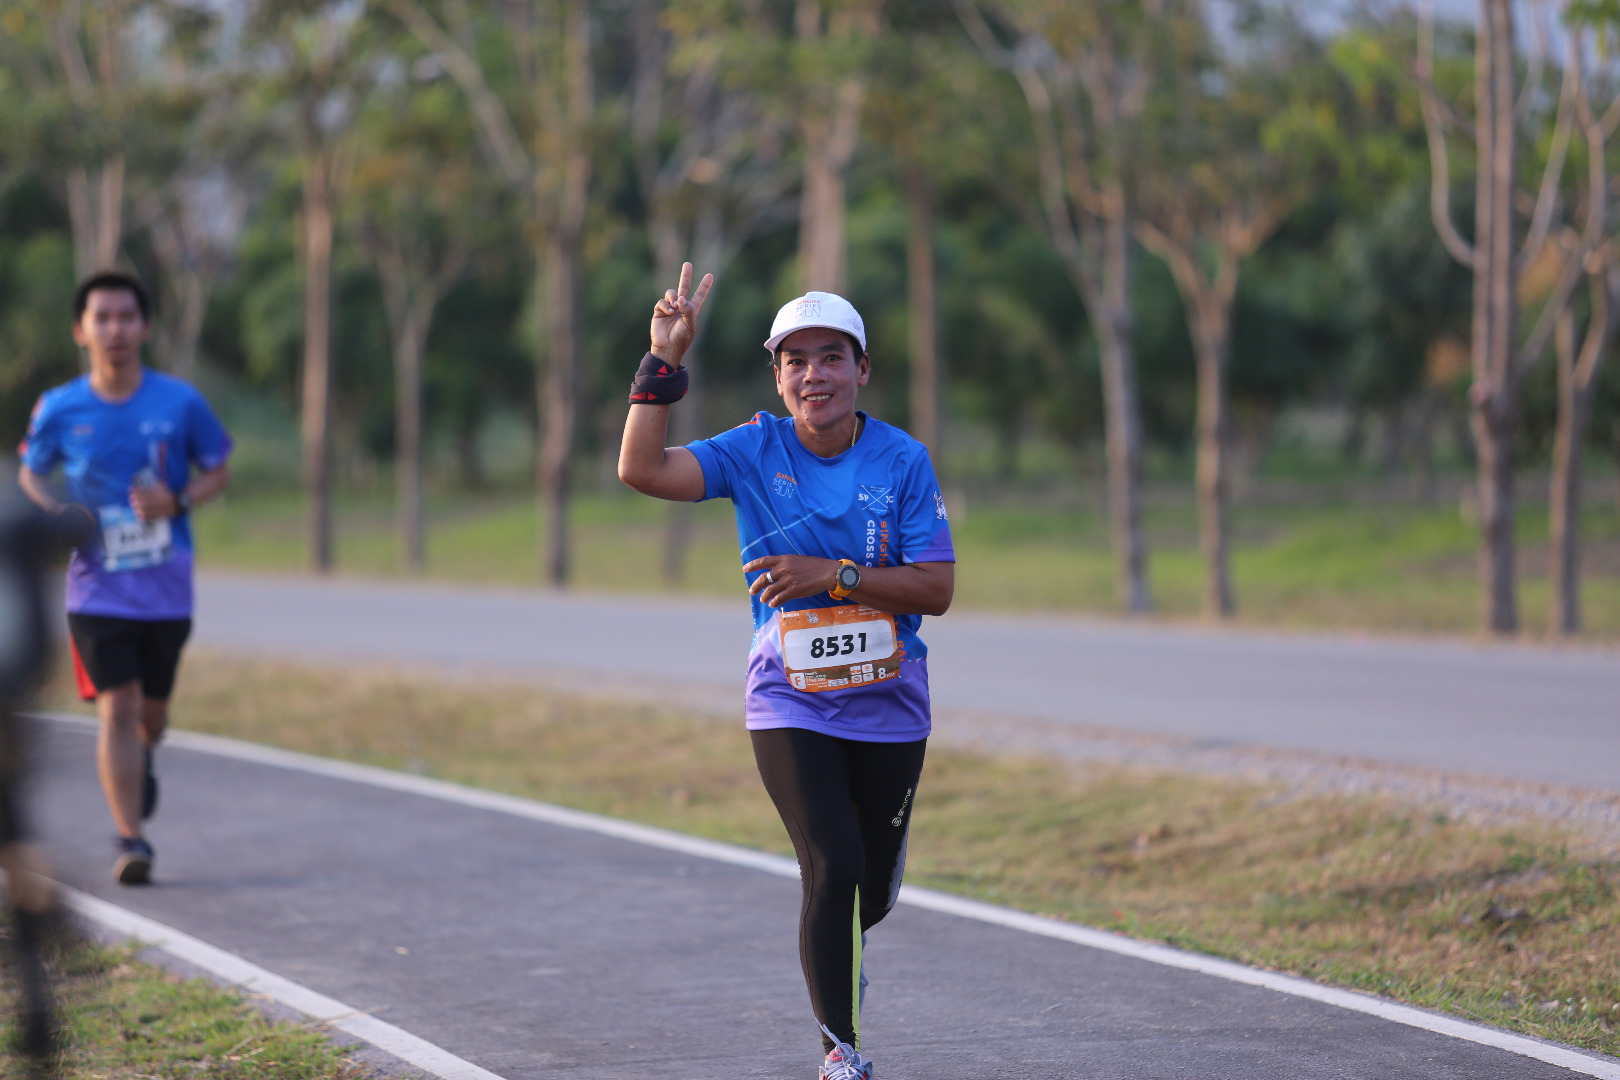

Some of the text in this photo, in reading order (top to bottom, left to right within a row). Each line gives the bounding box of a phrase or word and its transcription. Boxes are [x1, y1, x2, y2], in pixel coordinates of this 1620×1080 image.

[865, 519, 876, 559] CROSS
[879, 520, 889, 568] SINGHA
[810, 632, 867, 659] 8531
[793, 675, 802, 688] F
